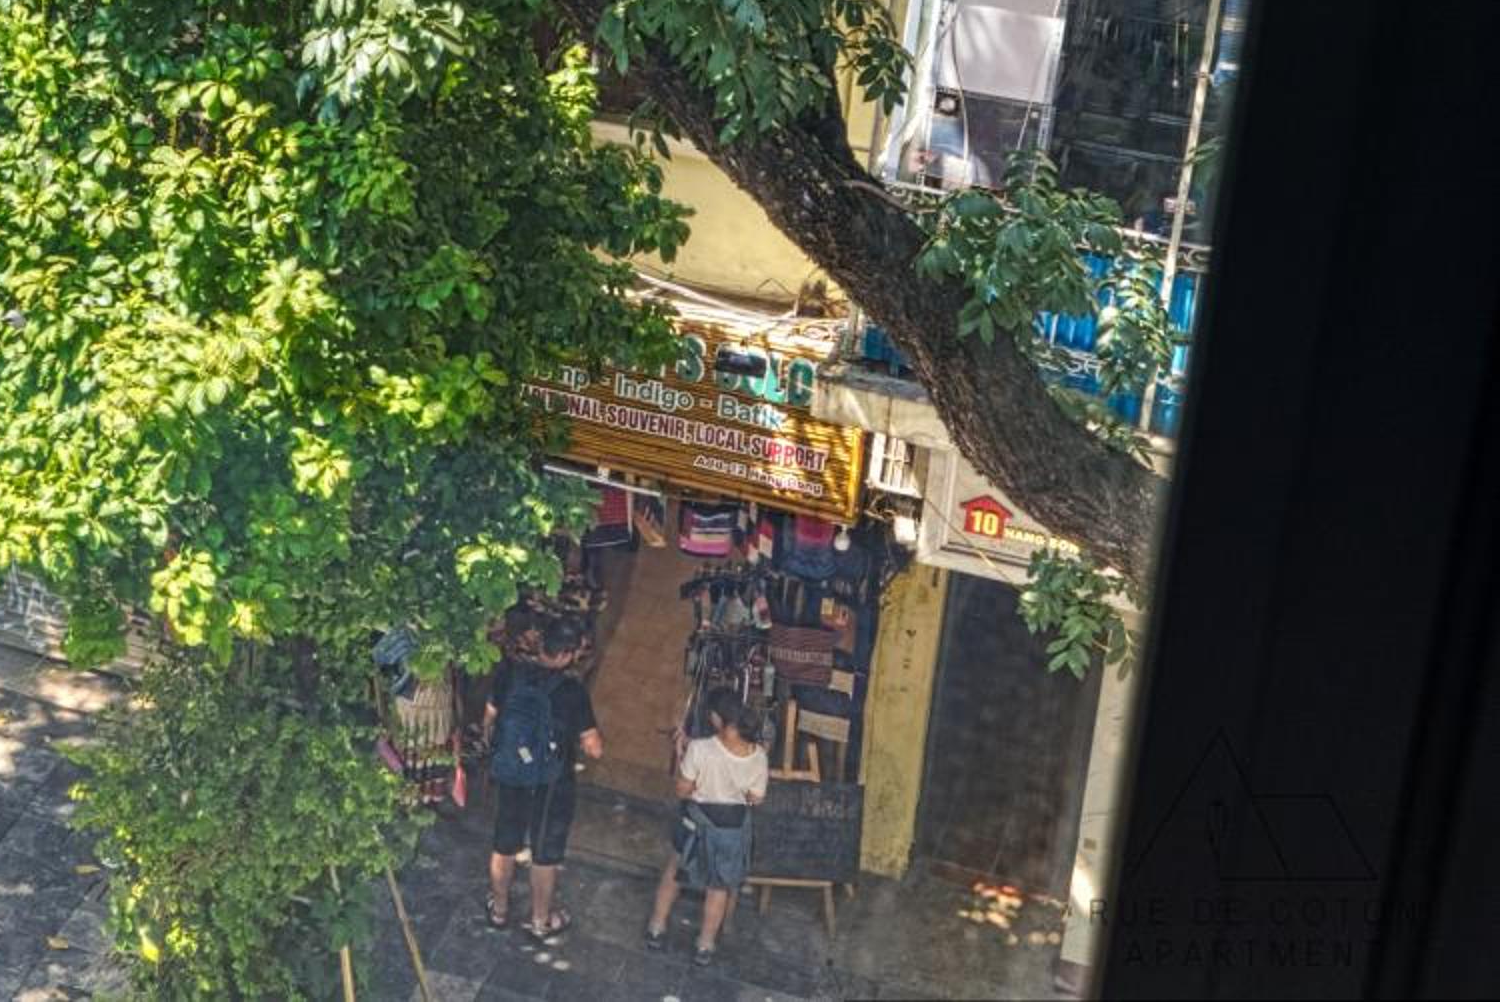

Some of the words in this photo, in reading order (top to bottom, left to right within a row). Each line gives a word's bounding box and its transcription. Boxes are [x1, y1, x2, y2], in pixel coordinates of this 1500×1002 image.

[615, 372, 695, 411] Indigo
[716, 393, 786, 430] Batik
[695, 422, 748, 454] LOCAL
[750, 436, 828, 471] SUPPORT
[972, 509, 998, 535] 10
